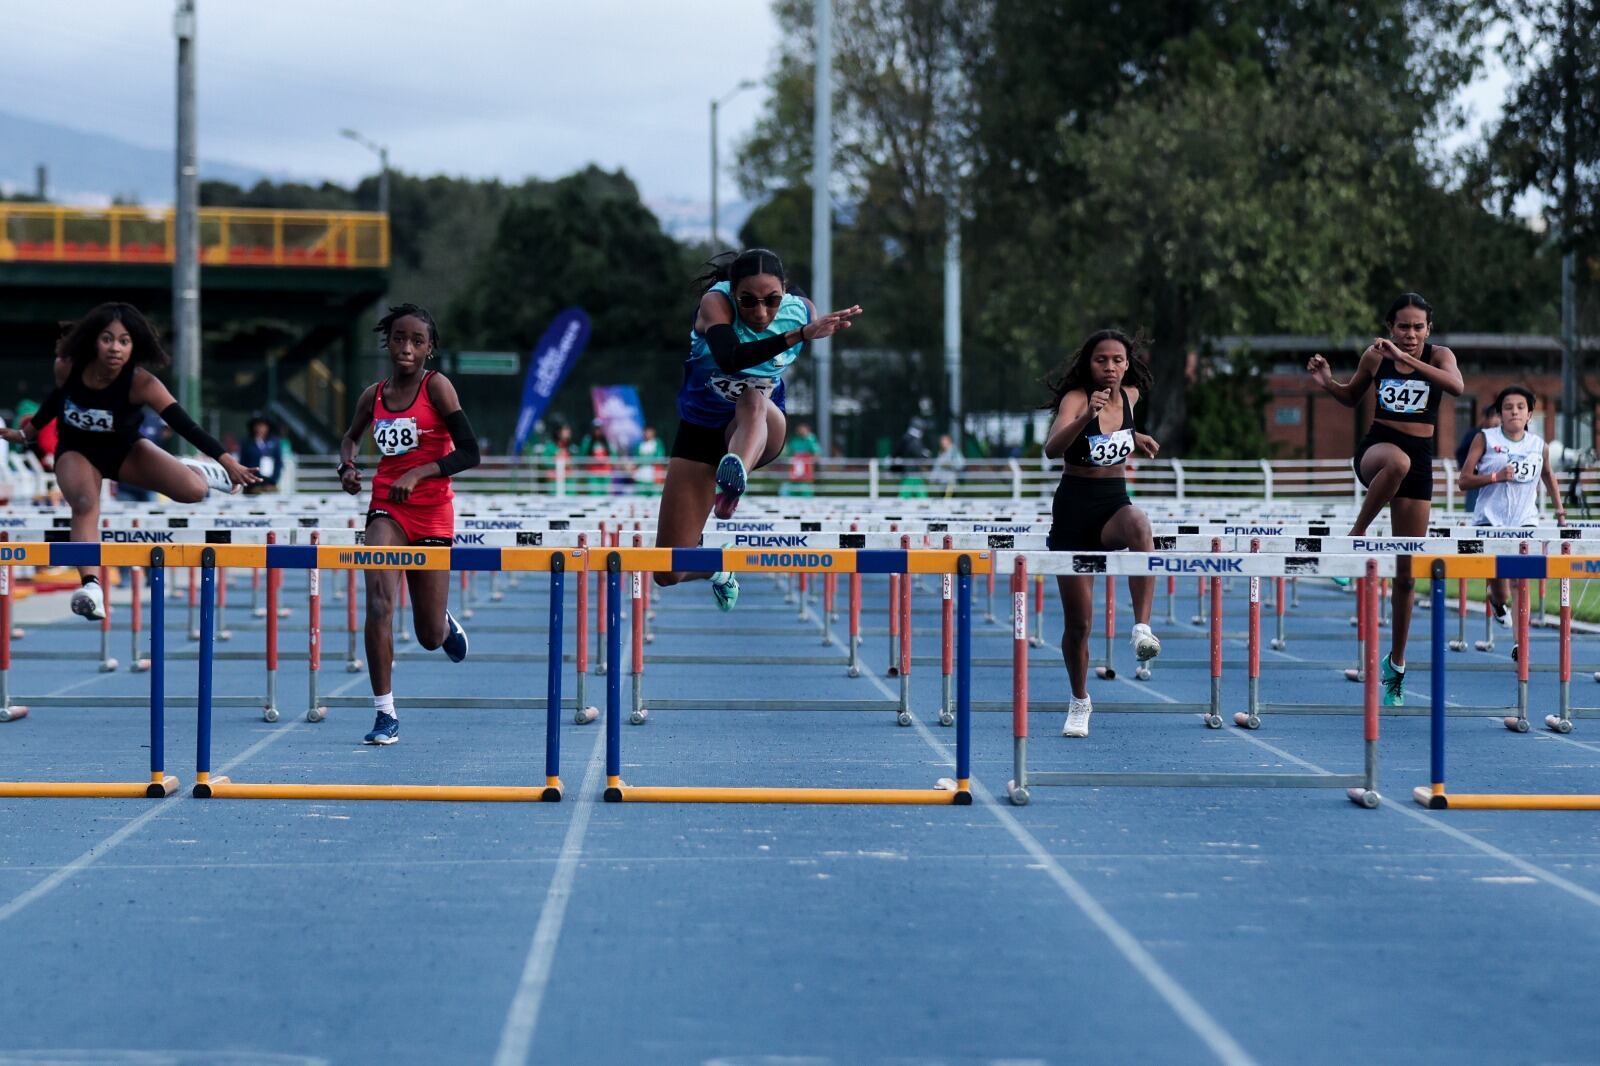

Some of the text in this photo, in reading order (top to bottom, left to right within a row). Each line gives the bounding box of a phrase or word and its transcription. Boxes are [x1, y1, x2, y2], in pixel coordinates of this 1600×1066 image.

[714, 380, 766, 398] 43
[1384, 387, 1425, 405] 347
[69, 412, 109, 428] 434
[378, 428, 413, 447] 438
[1094, 441, 1130, 460] 336
[465, 520, 523, 529] POLANIK
[716, 522, 775, 531] POLANIK
[1224, 526, 1283, 535] POLANIK
[101, 531, 174, 543] POLANIK
[735, 534, 807, 547] POLANIK
[1475, 529, 1534, 539] POLANIK
[1353, 540, 1426, 551] POLANIK
[354, 551, 426, 565] MONDO
[760, 553, 832, 567] MONDO
[1148, 557, 1243, 572] POLANIK
